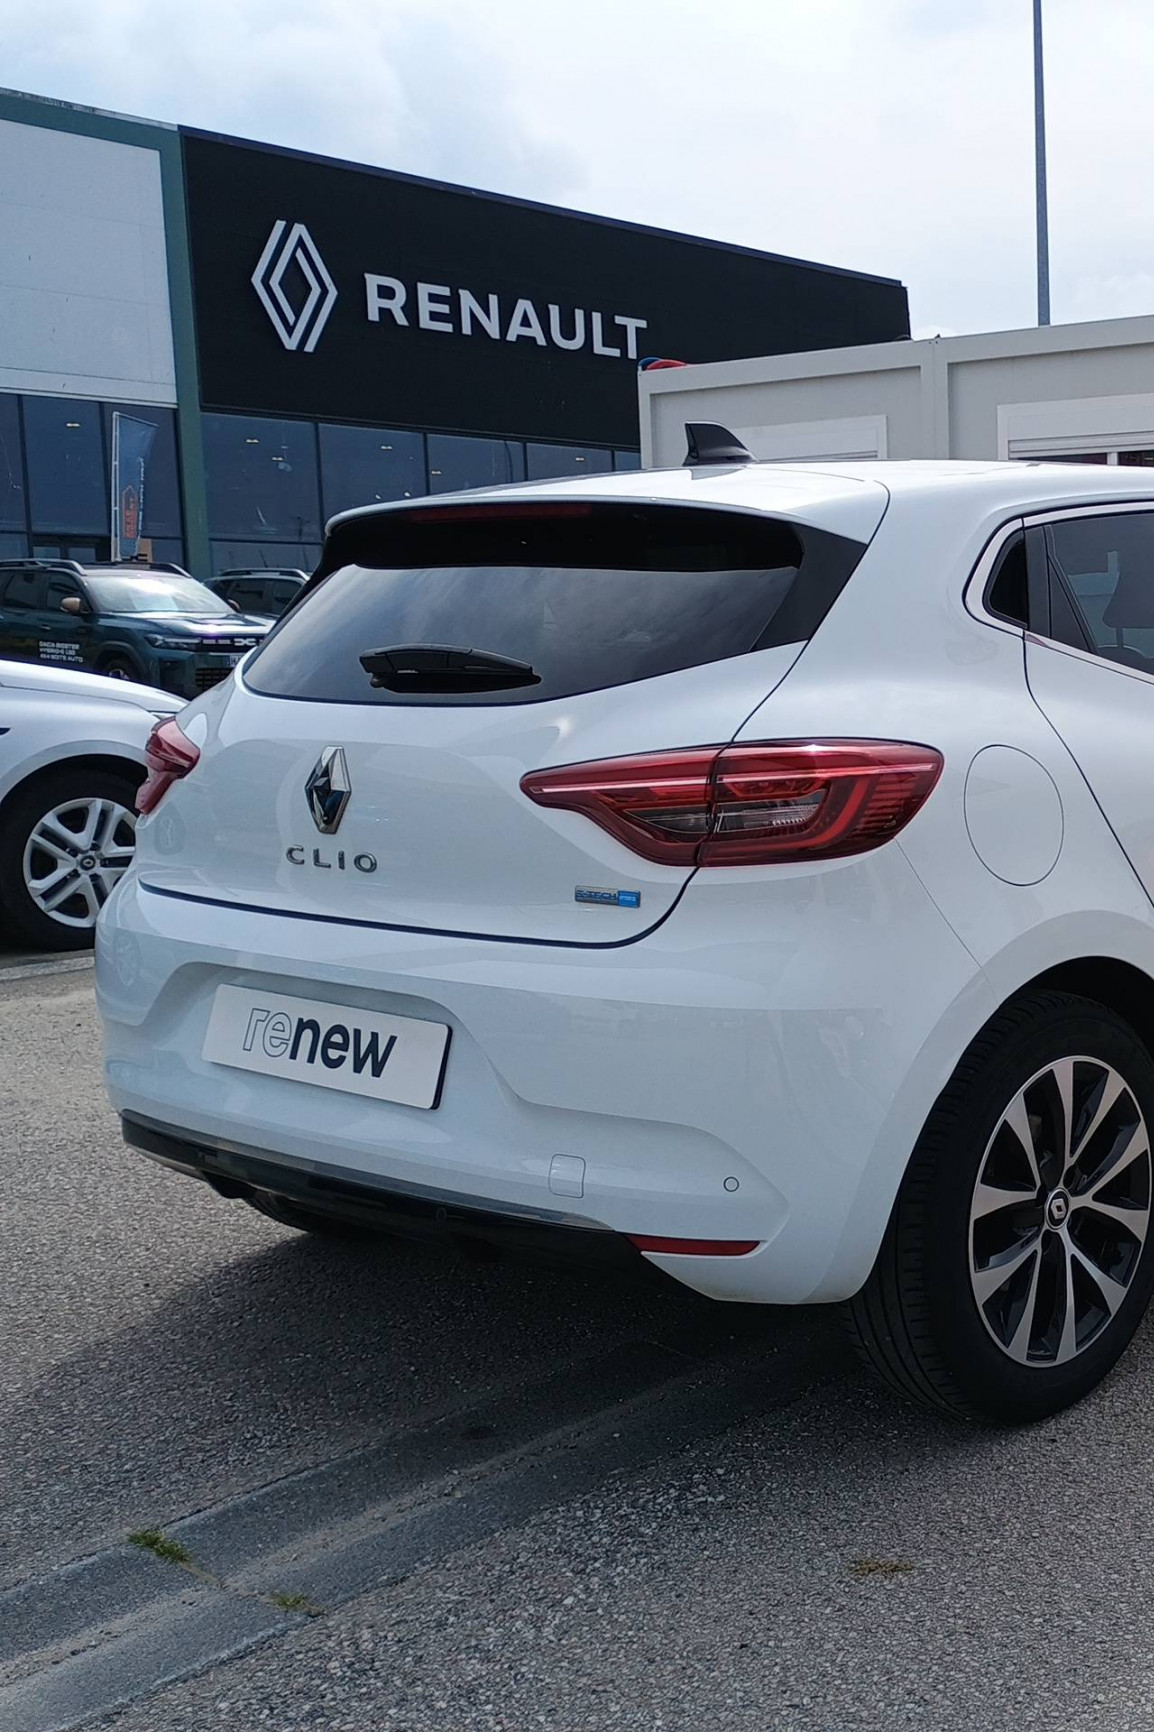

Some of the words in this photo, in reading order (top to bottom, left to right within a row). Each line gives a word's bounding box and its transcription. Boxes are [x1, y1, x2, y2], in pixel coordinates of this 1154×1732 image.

[365, 273, 648, 360] RENAULT
[286, 844, 379, 873] CLIO
[242, 1007, 398, 1078] renew
